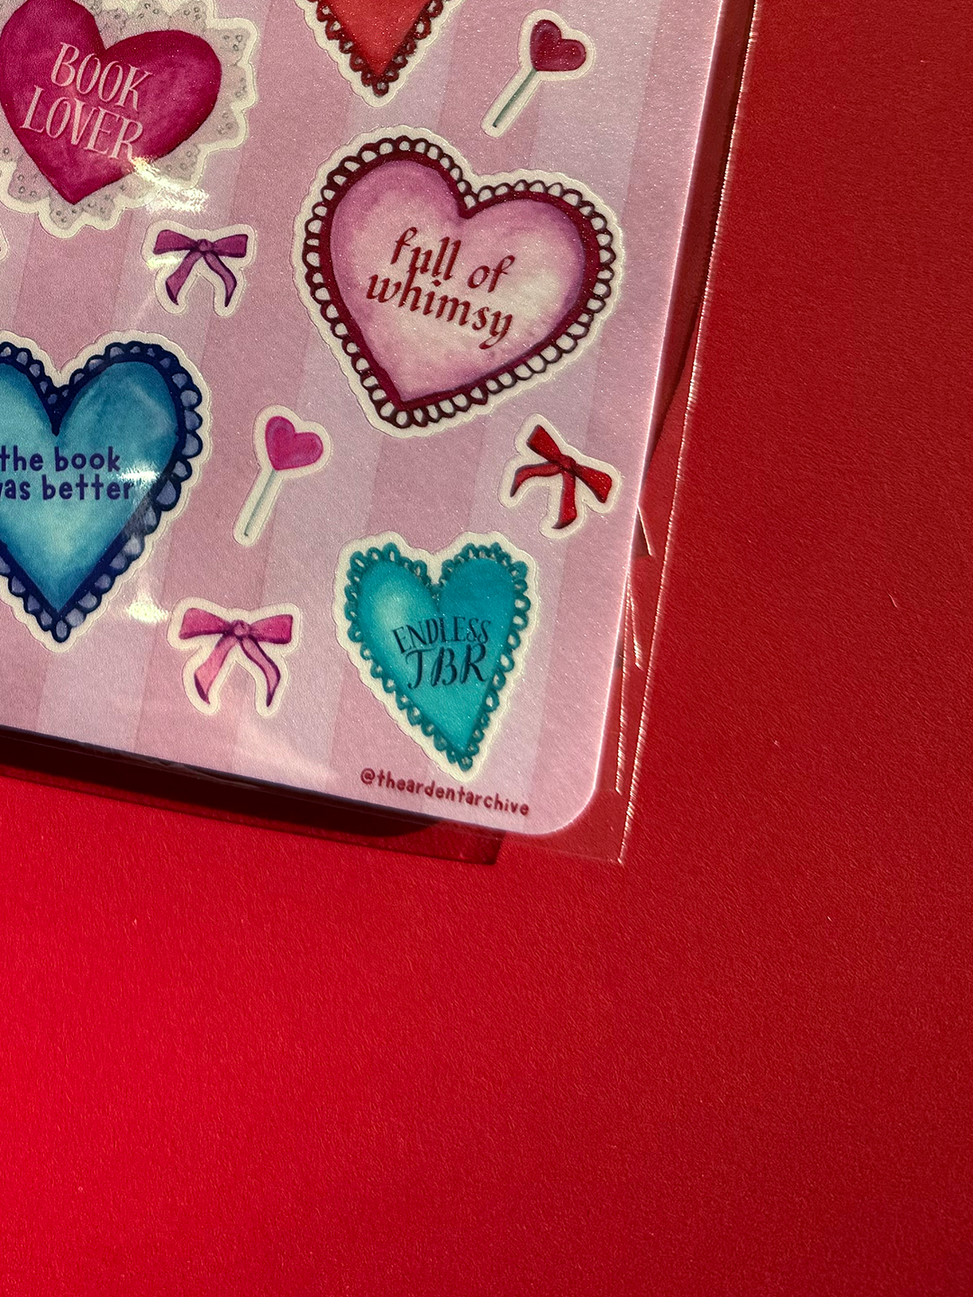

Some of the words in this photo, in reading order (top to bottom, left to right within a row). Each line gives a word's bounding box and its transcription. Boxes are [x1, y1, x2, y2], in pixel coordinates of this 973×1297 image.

[50, 41, 153, 112] BOOK
[19, 84, 145, 163] LOVER
[390, 226, 462, 281] full
[467, 254, 516, 293] of
[365, 266, 514, 350] whimsy
[54, 445, 121, 472] book
[41, 473, 135, 501] better
[392, 616, 491, 654] ENDLESS
[405, 643, 487, 690] TBR
[360, 767, 530, 816] @theardentarchive
